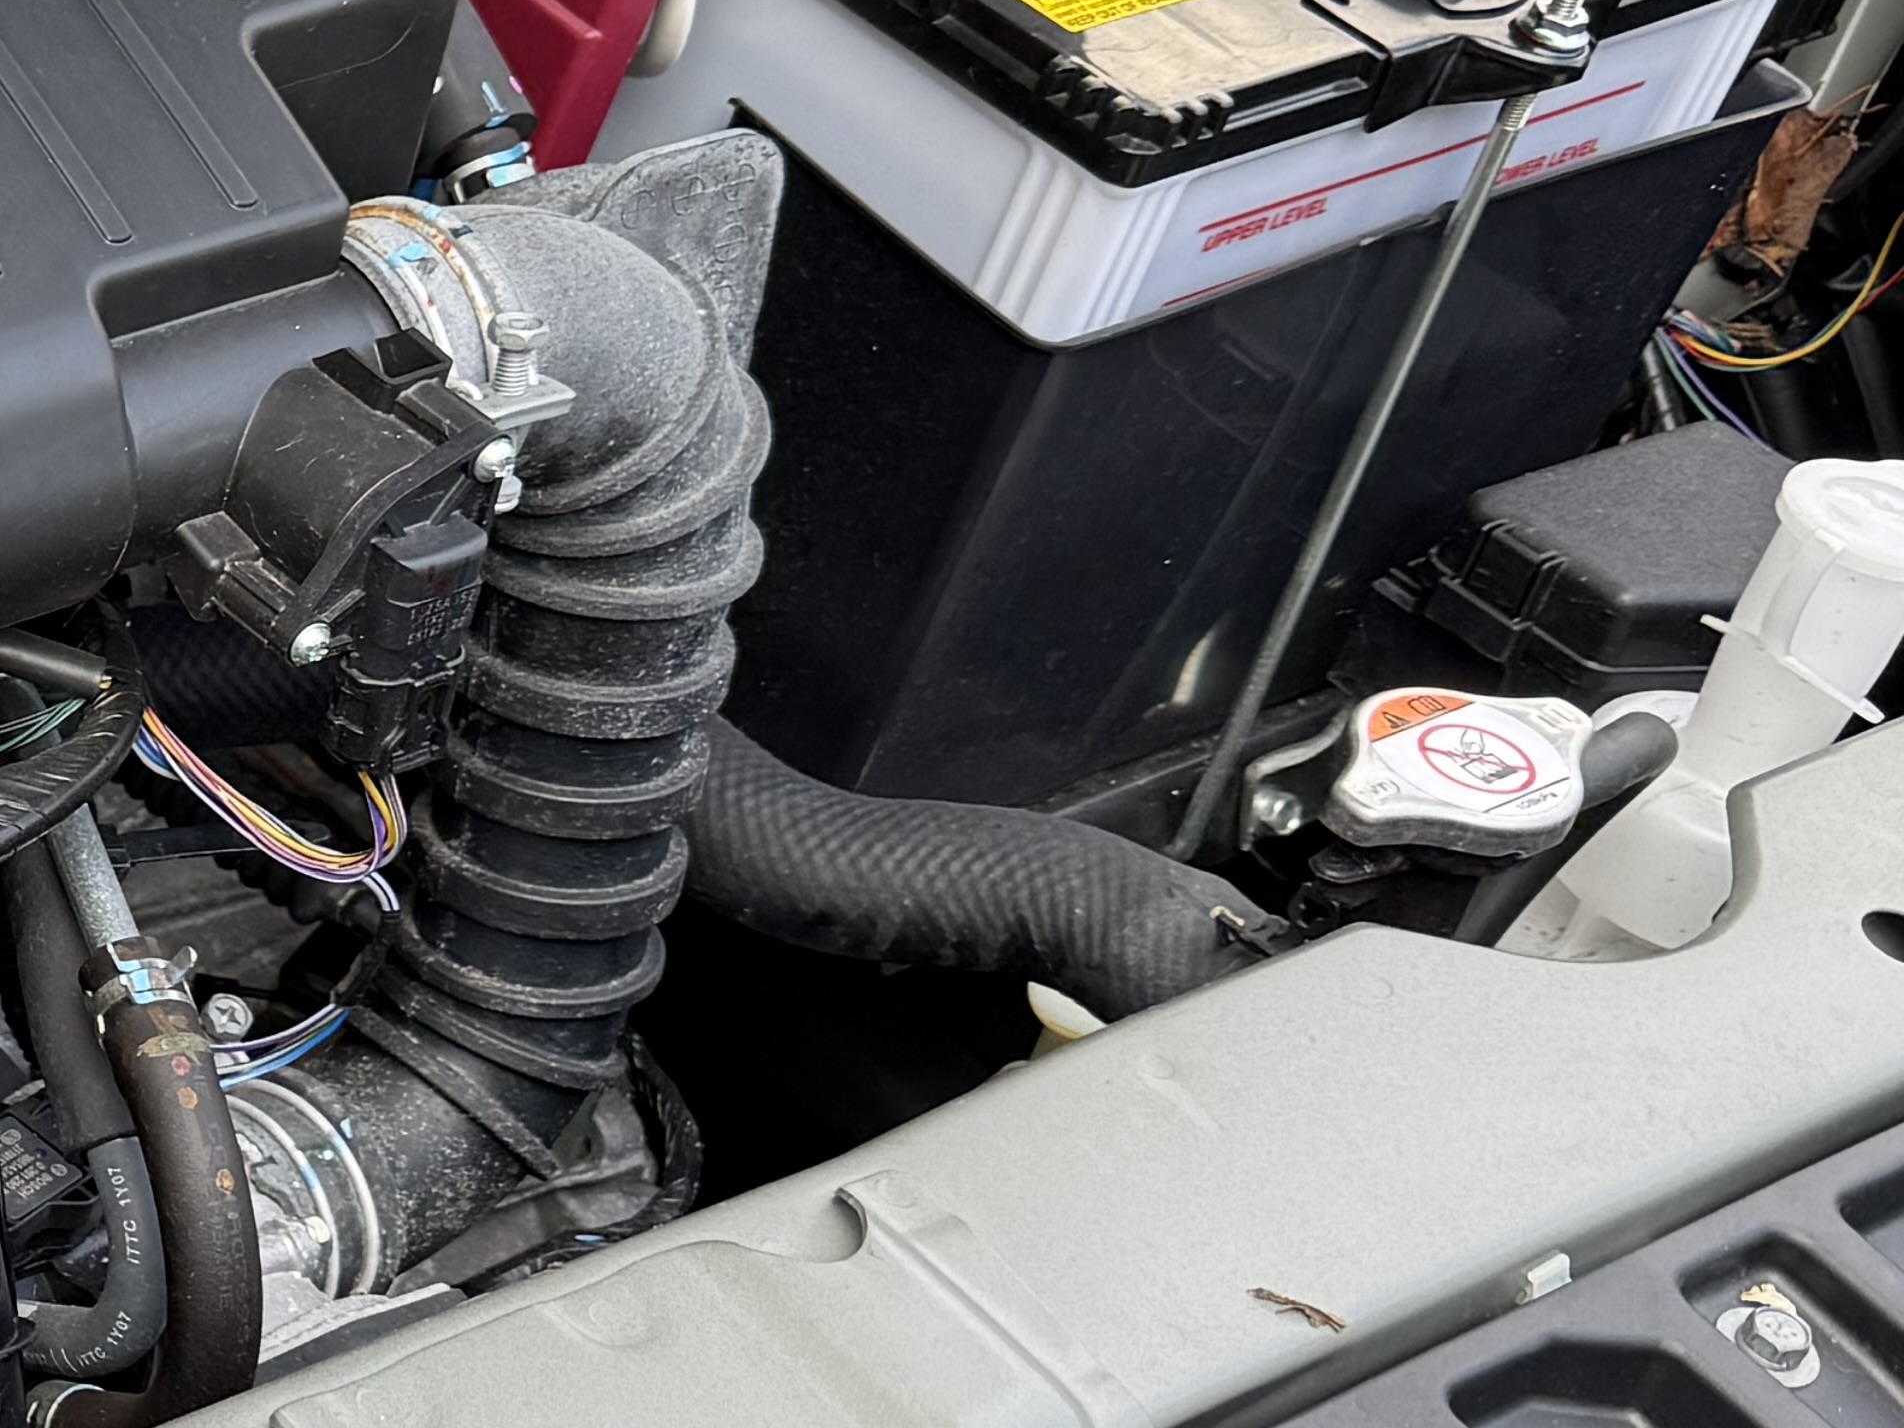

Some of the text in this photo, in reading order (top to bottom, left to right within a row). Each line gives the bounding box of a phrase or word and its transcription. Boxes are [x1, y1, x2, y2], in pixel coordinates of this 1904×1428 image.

[1545, 137, 1600, 173] LEVEL
[1201, 197, 1329, 253] UPPER LEVEL
[107, 1166, 141, 1265] ITTC 1Y07
[106, 1310, 133, 1346] 1Y07
